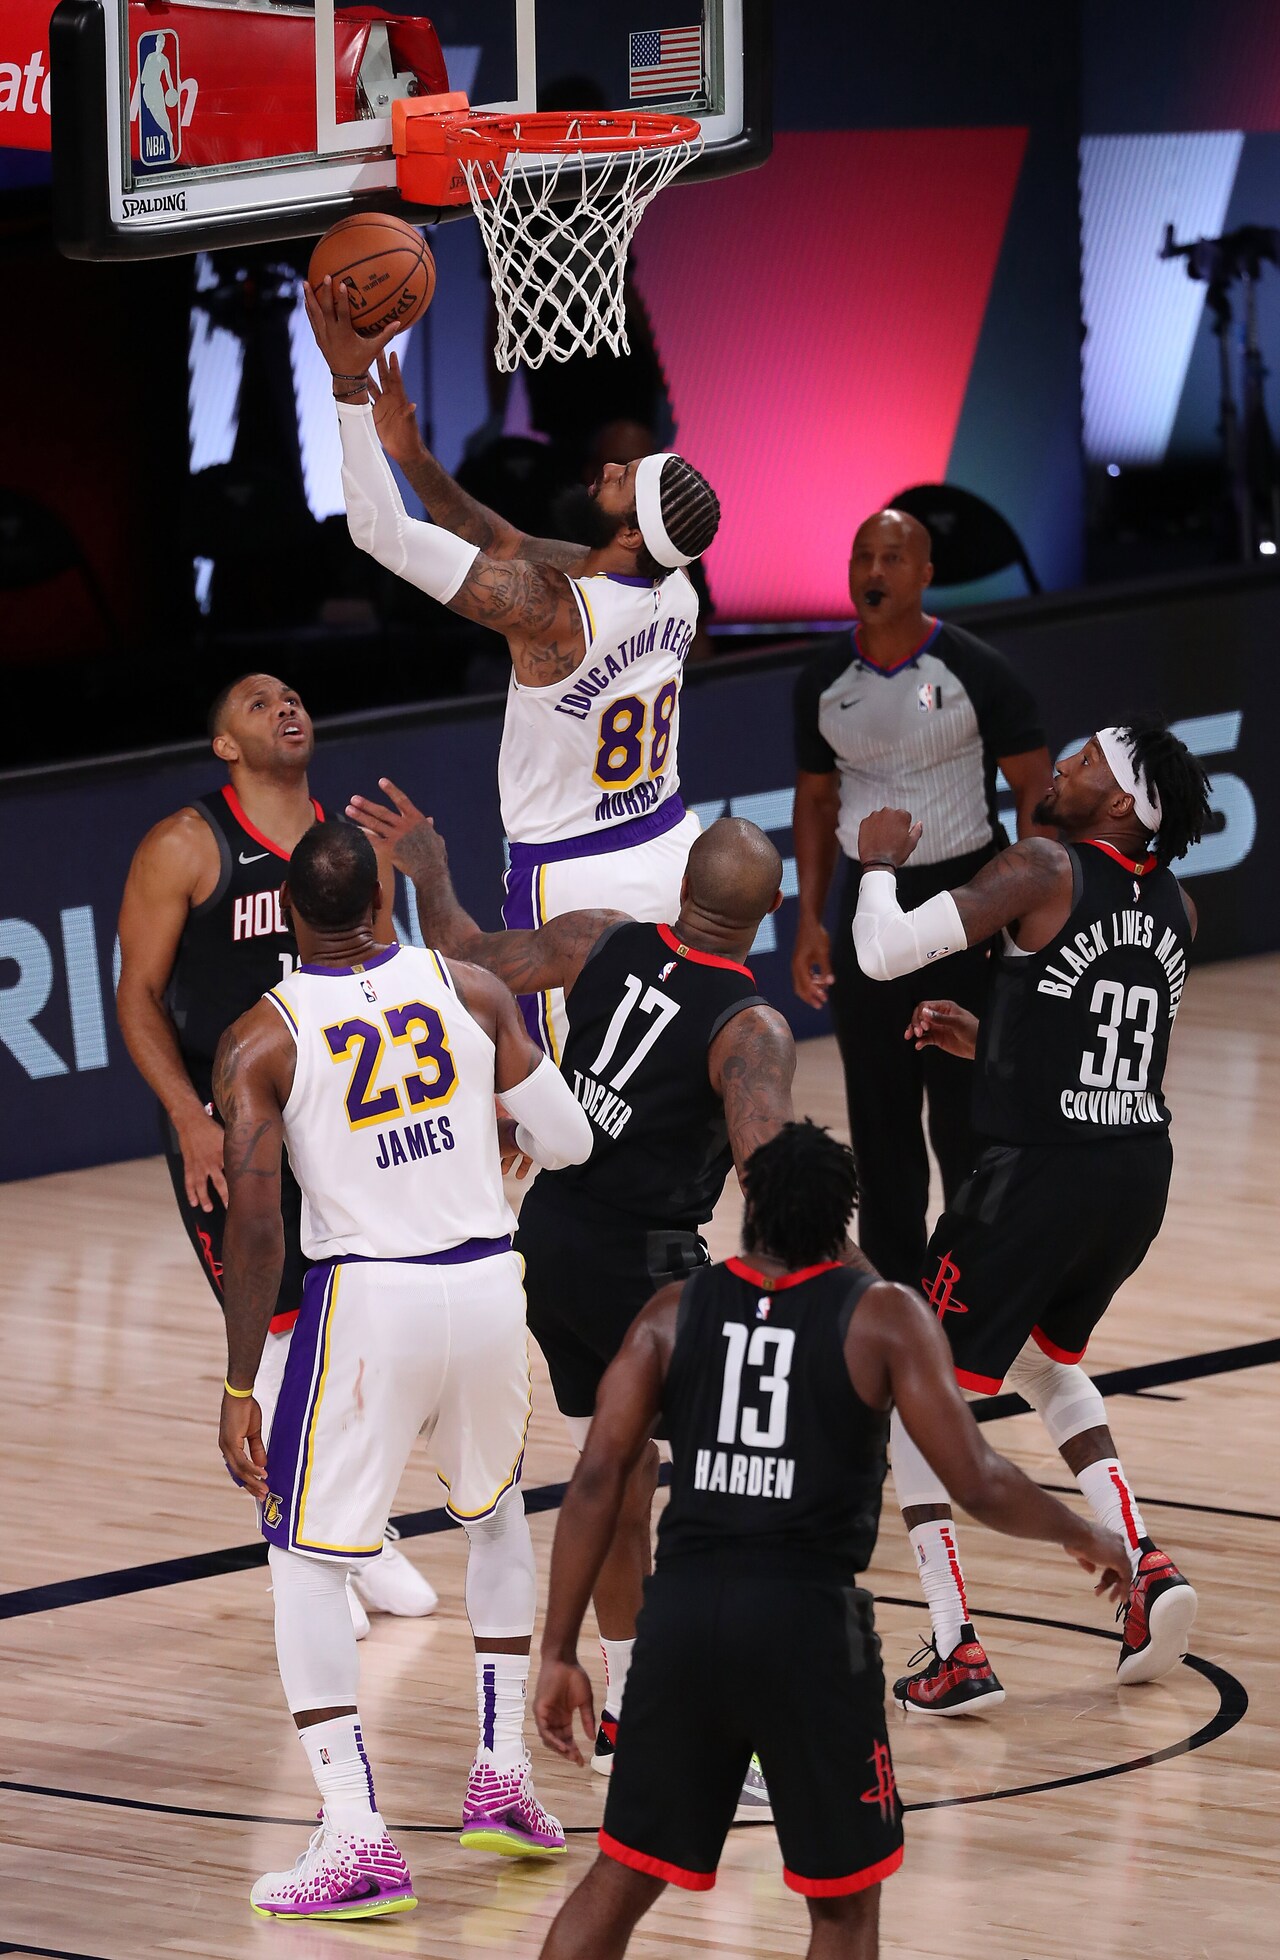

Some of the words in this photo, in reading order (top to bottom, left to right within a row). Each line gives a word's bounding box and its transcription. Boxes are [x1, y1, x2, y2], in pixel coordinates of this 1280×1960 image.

[146, 135, 166, 157] NBA
[122, 191, 188, 219] SPALDING
[554, 620, 660, 721] EDUCATION
[592, 677, 677, 791] 88
[1037, 920, 1108, 999] BLACK
[1112, 910, 1154, 948] LIVES
[320, 999, 460, 1133] 23
[589, 973, 682, 1092] 17
[1079, 979, 1158, 1091] 33
[376, 1115, 455, 1169] JAMES
[573, 1069, 633, 1140] TUCKER
[1060, 1089, 1164, 1125] COVINGTON
[716, 1321, 796, 1449] 13
[694, 1449, 796, 1500] HARDEN
